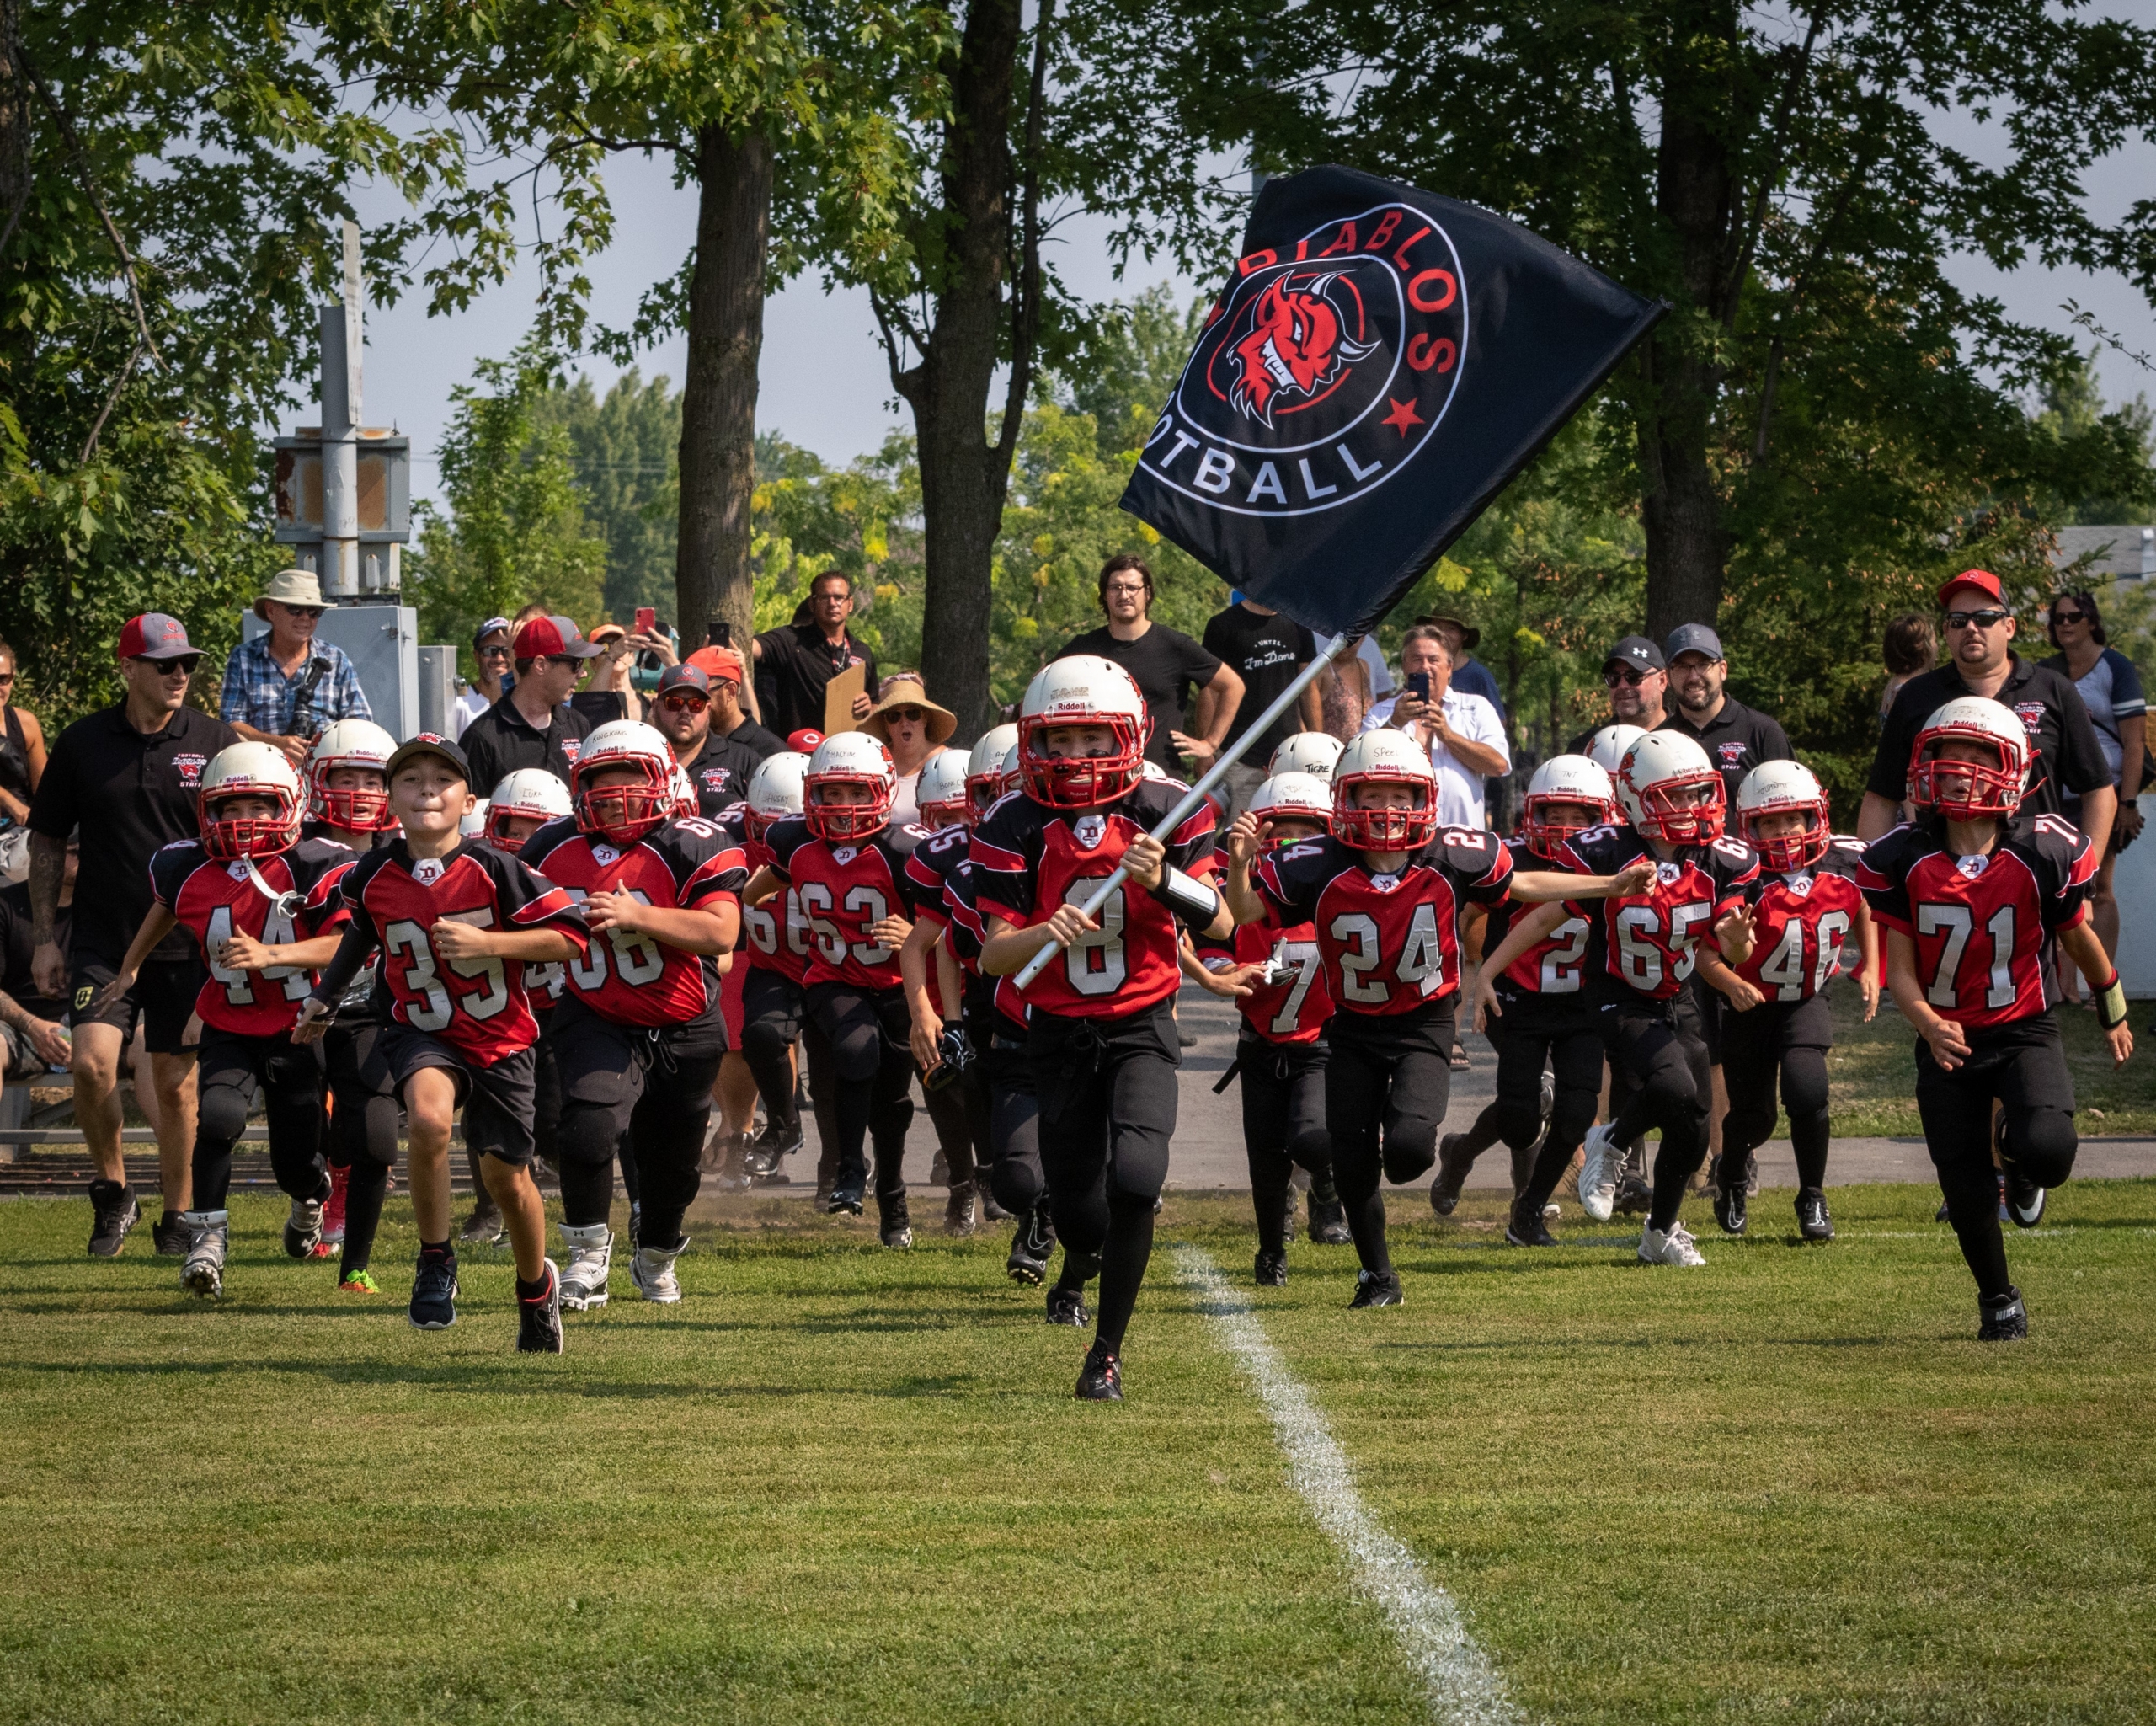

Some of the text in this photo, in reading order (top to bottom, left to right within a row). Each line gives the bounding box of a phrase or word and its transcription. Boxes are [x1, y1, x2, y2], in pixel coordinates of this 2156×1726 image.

[1238, 211, 1457, 373] DIABLOS
[1145, 391, 1382, 504] OTBALL
[1264, 650, 1295, 665] Done
[803, 733, 819, 744] C
[1058, 702, 1086, 710] Riddell
[1305, 763, 1330, 773] TIGRE
[206, 904, 312, 1006] 44
[385, 905, 510, 1033] 35
[798, 880, 893, 965] 63
[1063, 875, 1129, 996] 8
[1329, 900, 1444, 1004] 24
[1540, 916, 1591, 994] 2
[1616, 900, 1712, 992] 65
[1758, 909, 1851, 1002] 46
[1917, 900, 2018, 1010] 71
[1270, 940, 1321, 1034] 7
[1995, 1306, 2017, 1321] NIKE
